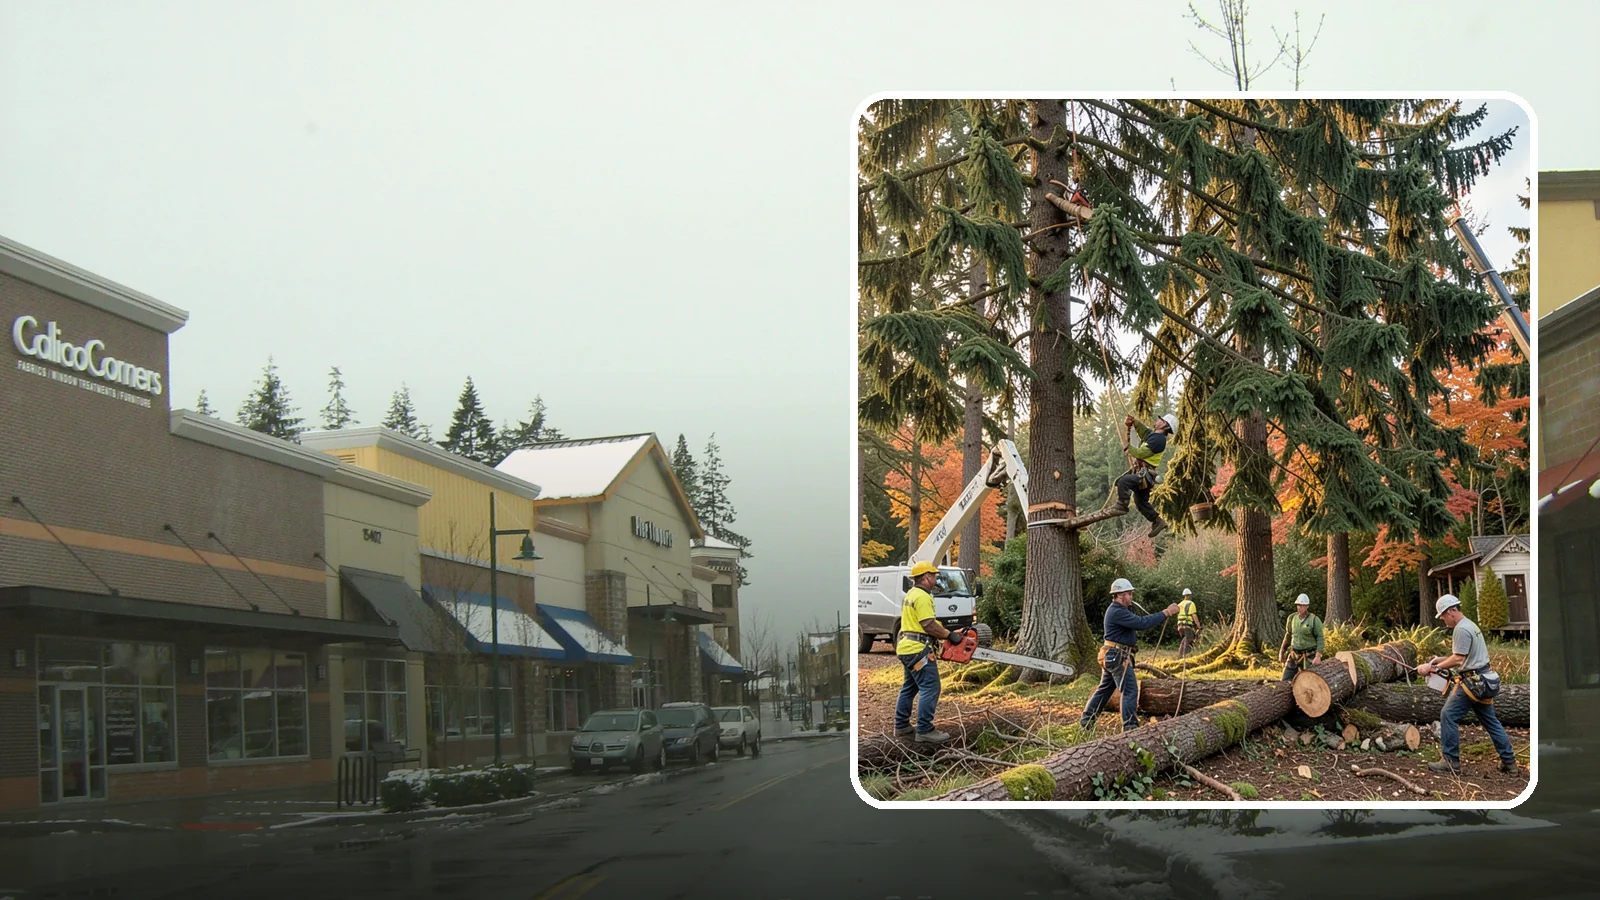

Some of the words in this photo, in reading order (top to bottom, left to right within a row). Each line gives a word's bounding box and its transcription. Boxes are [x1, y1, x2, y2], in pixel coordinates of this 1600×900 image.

[17, 360, 47, 377] FABRICS
[51, 370, 79, 387] WINDOW
[79, 378, 117, 399] TREATMENTS
[120, 391, 151, 408] FURNITURE
